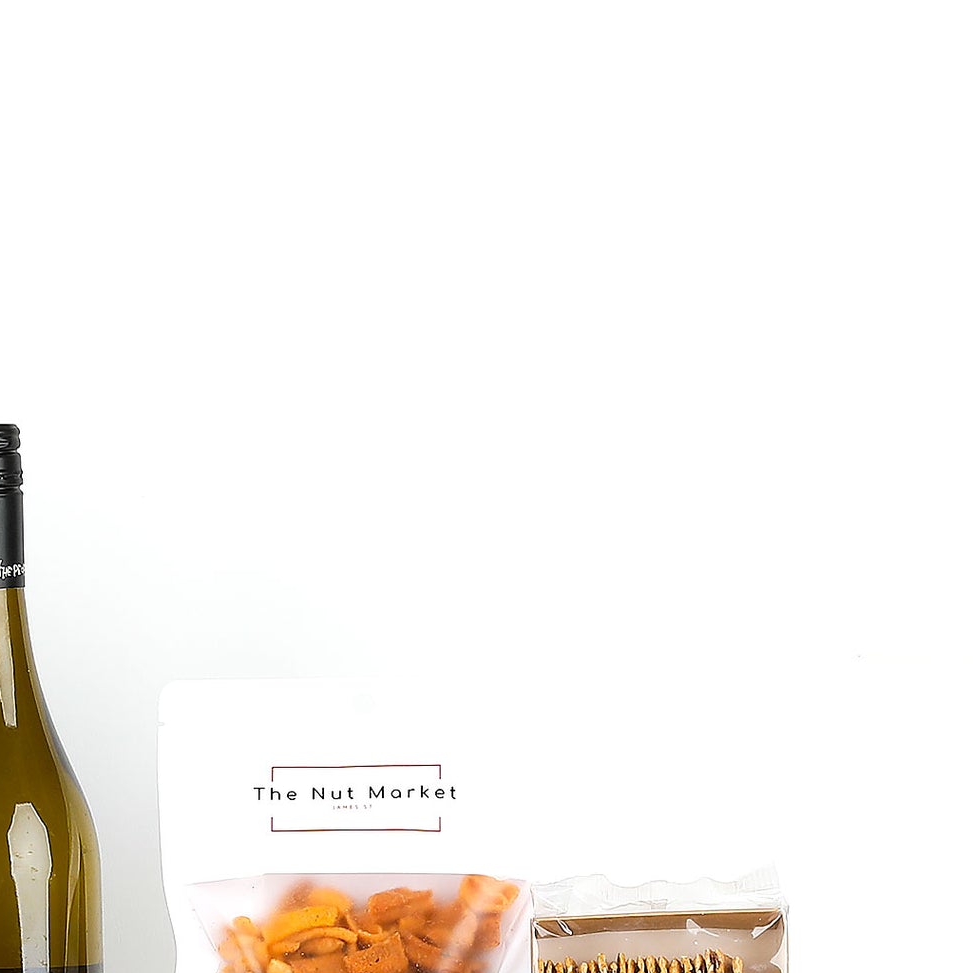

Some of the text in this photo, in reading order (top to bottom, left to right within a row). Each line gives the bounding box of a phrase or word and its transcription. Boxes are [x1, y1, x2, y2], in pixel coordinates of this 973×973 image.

[254, 785, 456, 801] The Nut Market
